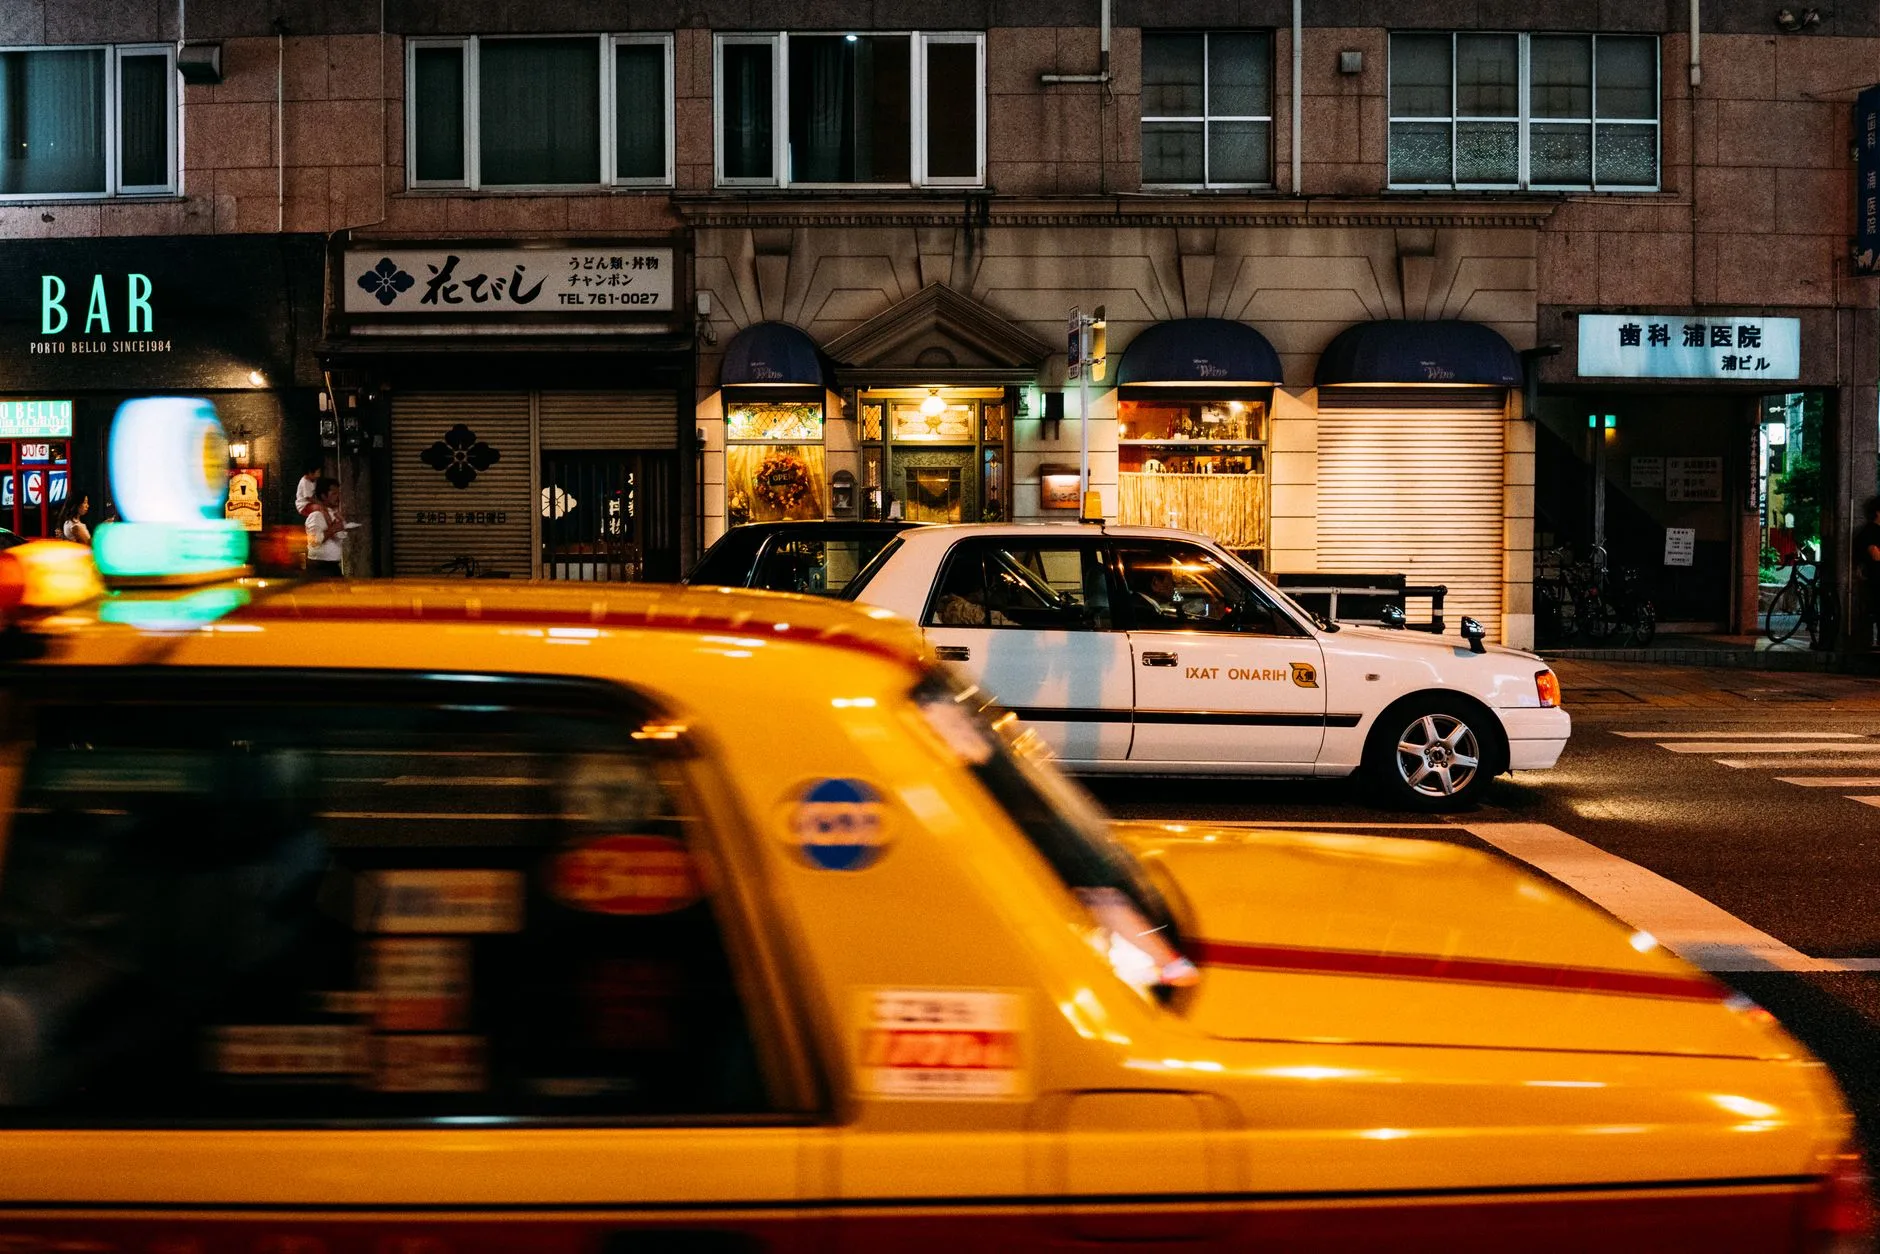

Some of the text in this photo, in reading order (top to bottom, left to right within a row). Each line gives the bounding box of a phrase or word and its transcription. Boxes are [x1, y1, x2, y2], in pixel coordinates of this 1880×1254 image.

[420, 255, 549, 305] 花びし
[567, 274, 634, 287] チャンポン
[41, 273, 153, 334] BAR
[558, 293, 659, 305] TEL 761-0027
[1618, 323, 1762, 348] 歯科 浦医院
[30, 340, 171, 354] PORTO BELLO SINCE1984
[1721, 355, 1771, 371] 浦ビル
[1185, 667, 1287, 681] IXAT ONARIH
